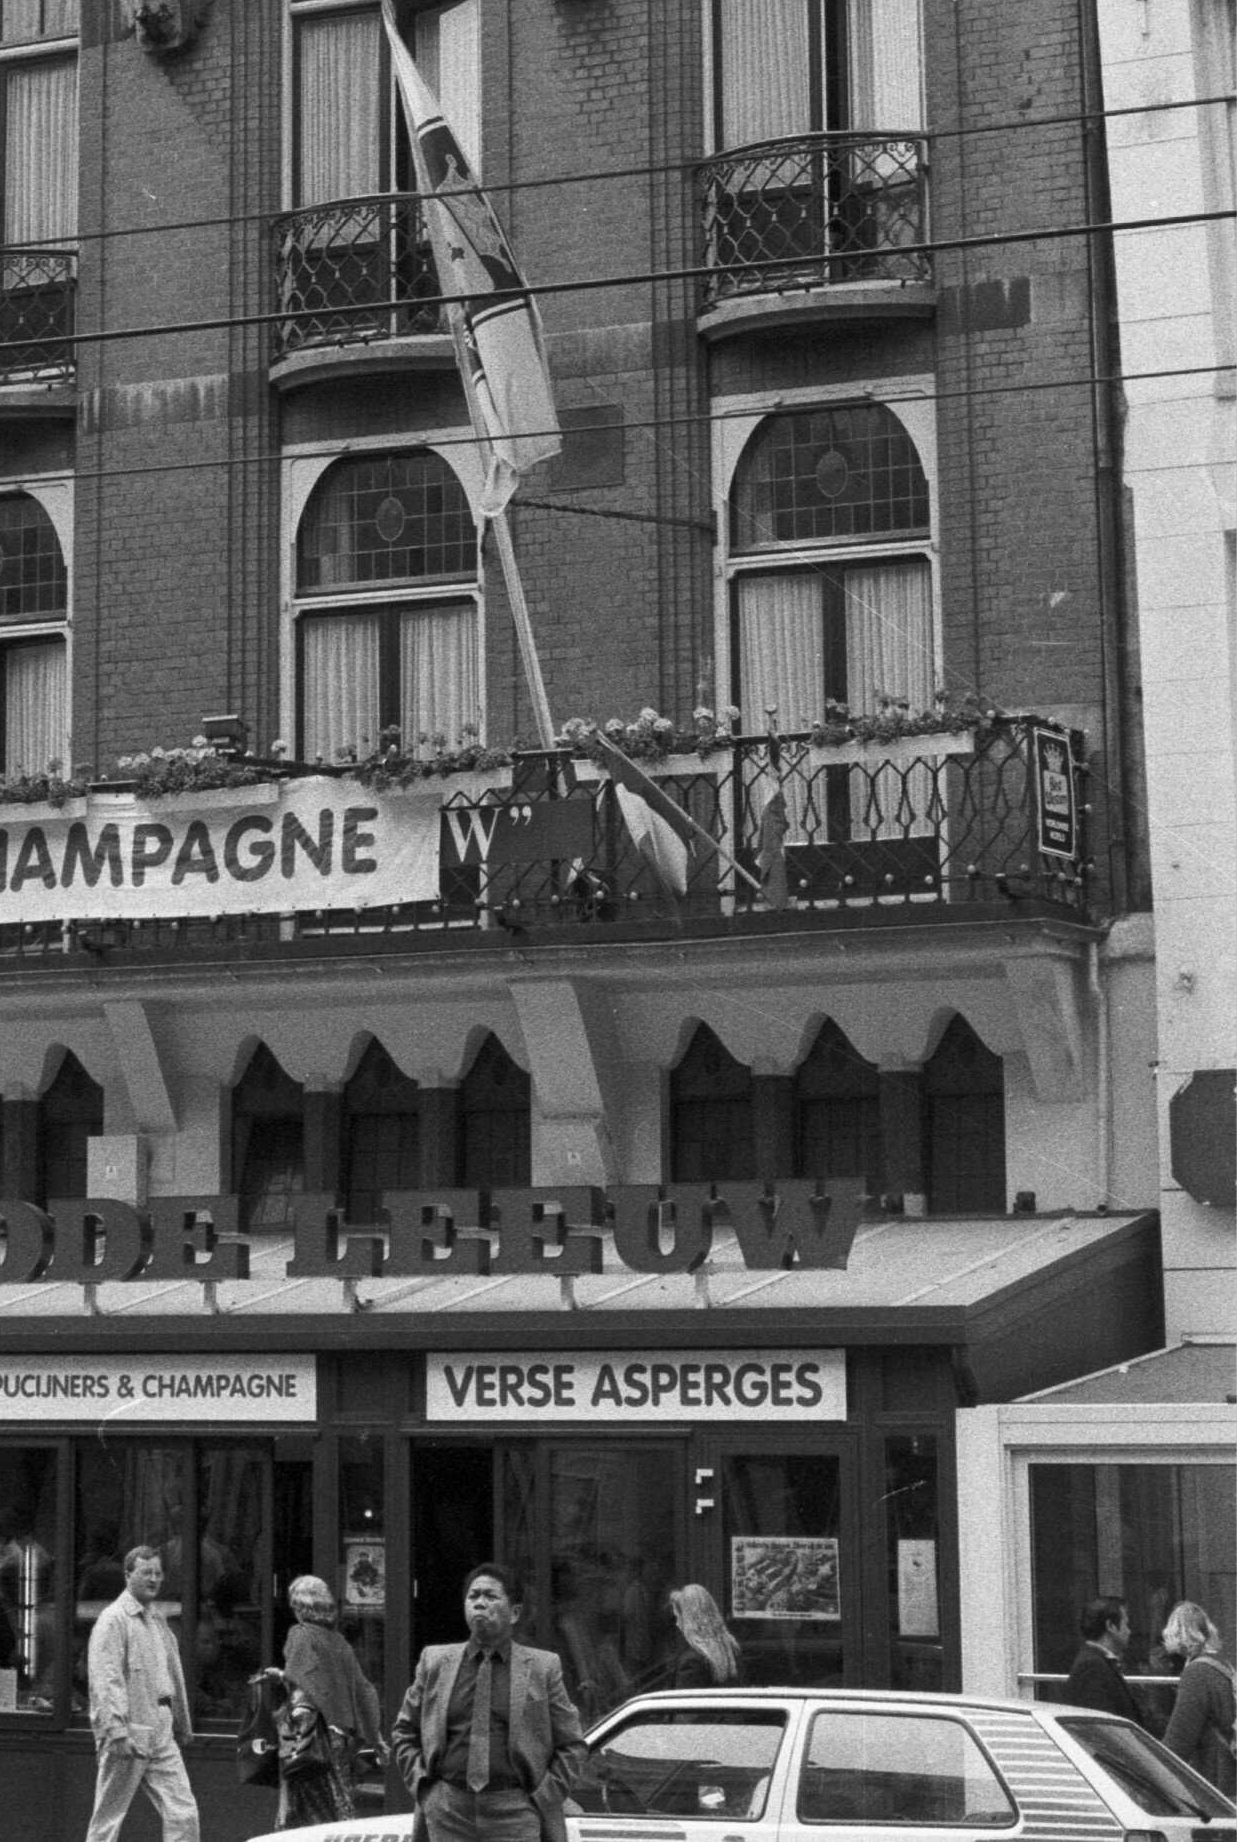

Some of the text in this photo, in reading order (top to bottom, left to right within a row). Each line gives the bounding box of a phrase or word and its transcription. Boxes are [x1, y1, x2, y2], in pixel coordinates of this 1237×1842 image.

[286, 1178, 871, 1278] LEEUW
[116, 1374, 134, 1398] &
[141, 1373, 297, 1399] CHAMPAGNE
[443, 1362, 823, 1408] VERSE ASPERGES
